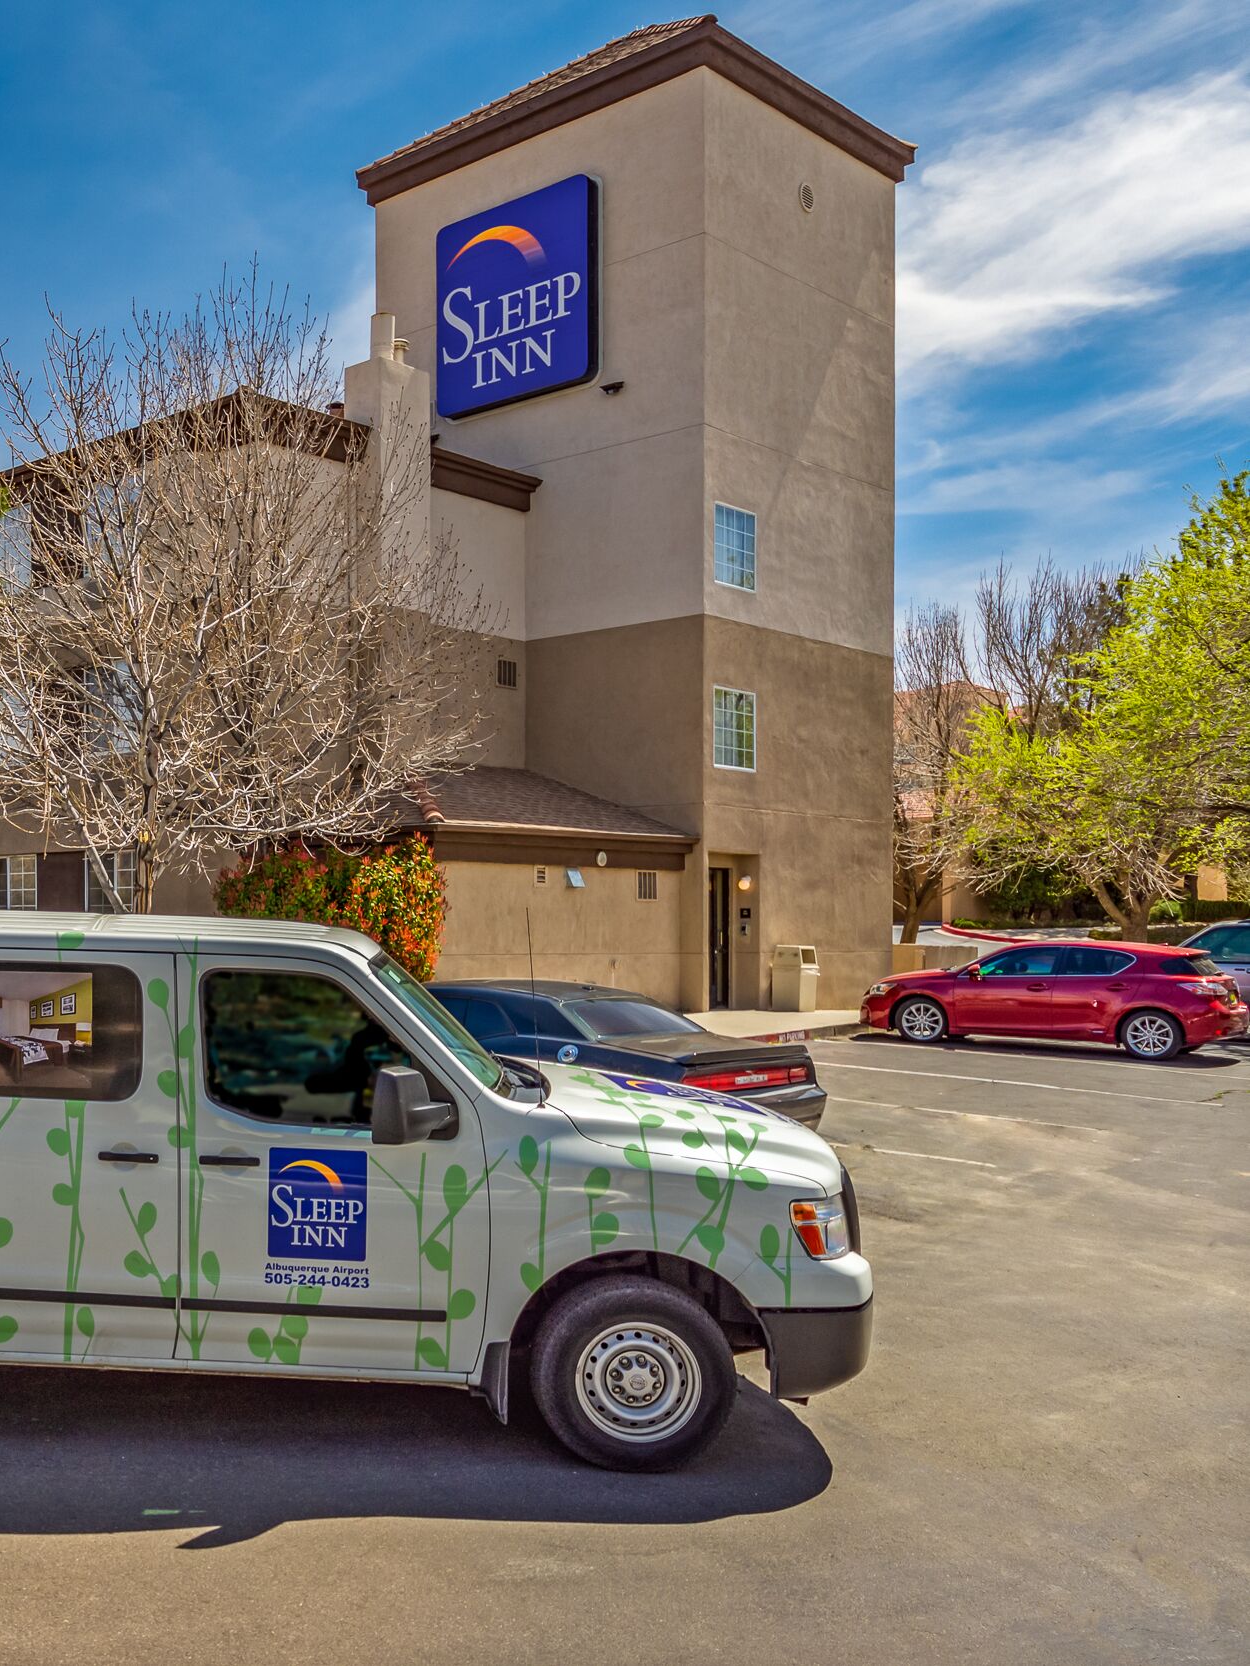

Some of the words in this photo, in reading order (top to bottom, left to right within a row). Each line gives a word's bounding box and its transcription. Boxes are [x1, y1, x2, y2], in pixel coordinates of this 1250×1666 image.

[472, 329, 555, 388] INN
[290, 1225, 347, 1247] INN
[265, 1262, 330, 1273] Albuquerque
[332, 1265, 369, 1275] Airport
[264, 1272, 370, 1289] 505-244-0423
